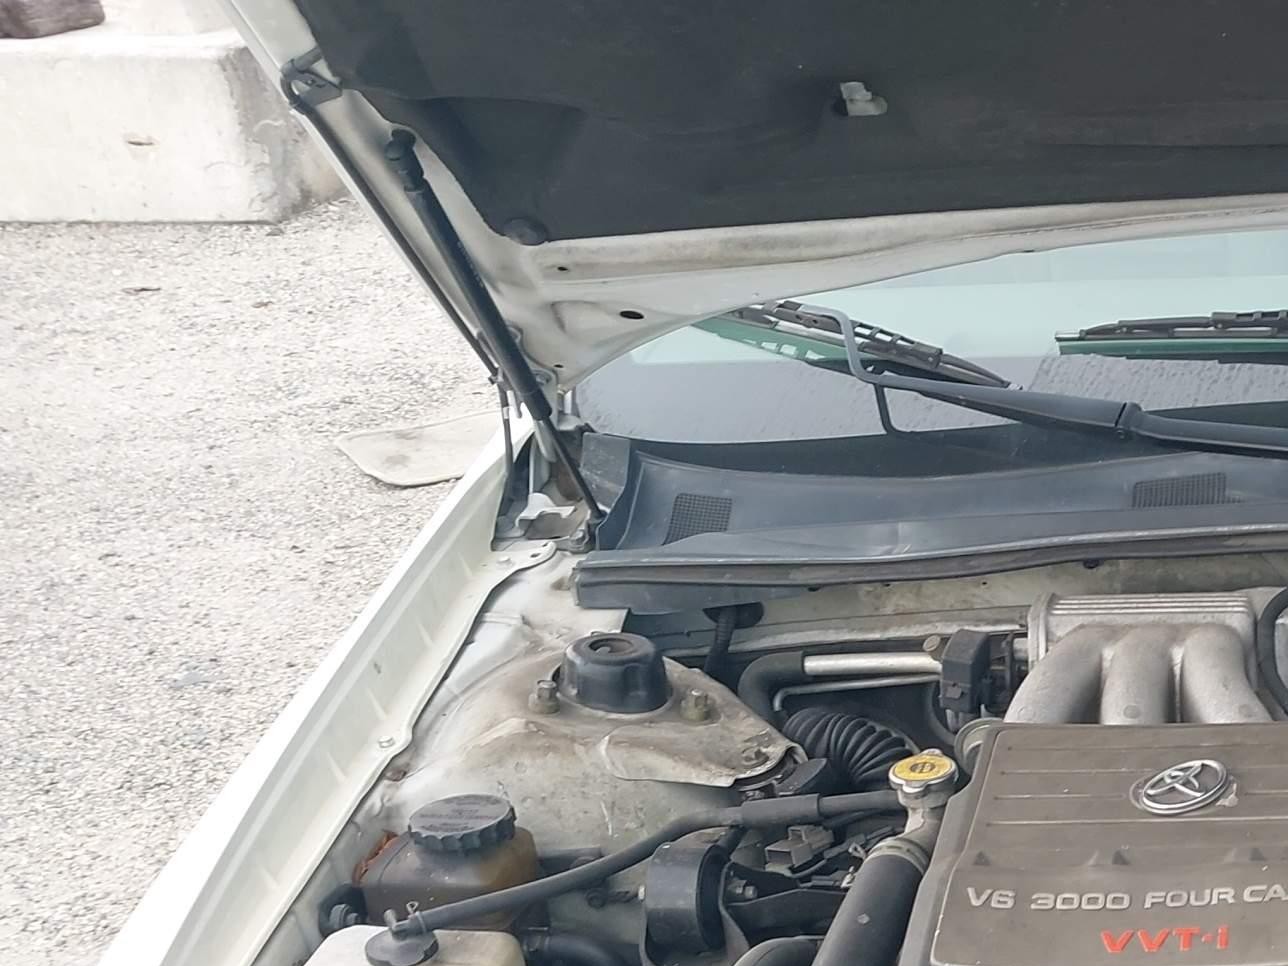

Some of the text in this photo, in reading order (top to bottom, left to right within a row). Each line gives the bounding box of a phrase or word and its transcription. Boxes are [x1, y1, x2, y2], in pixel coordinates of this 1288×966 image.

[966, 887, 1016, 910] V6
[1030, 892, 1131, 911] 3000
[1143, 886, 1236, 910] FOUR
